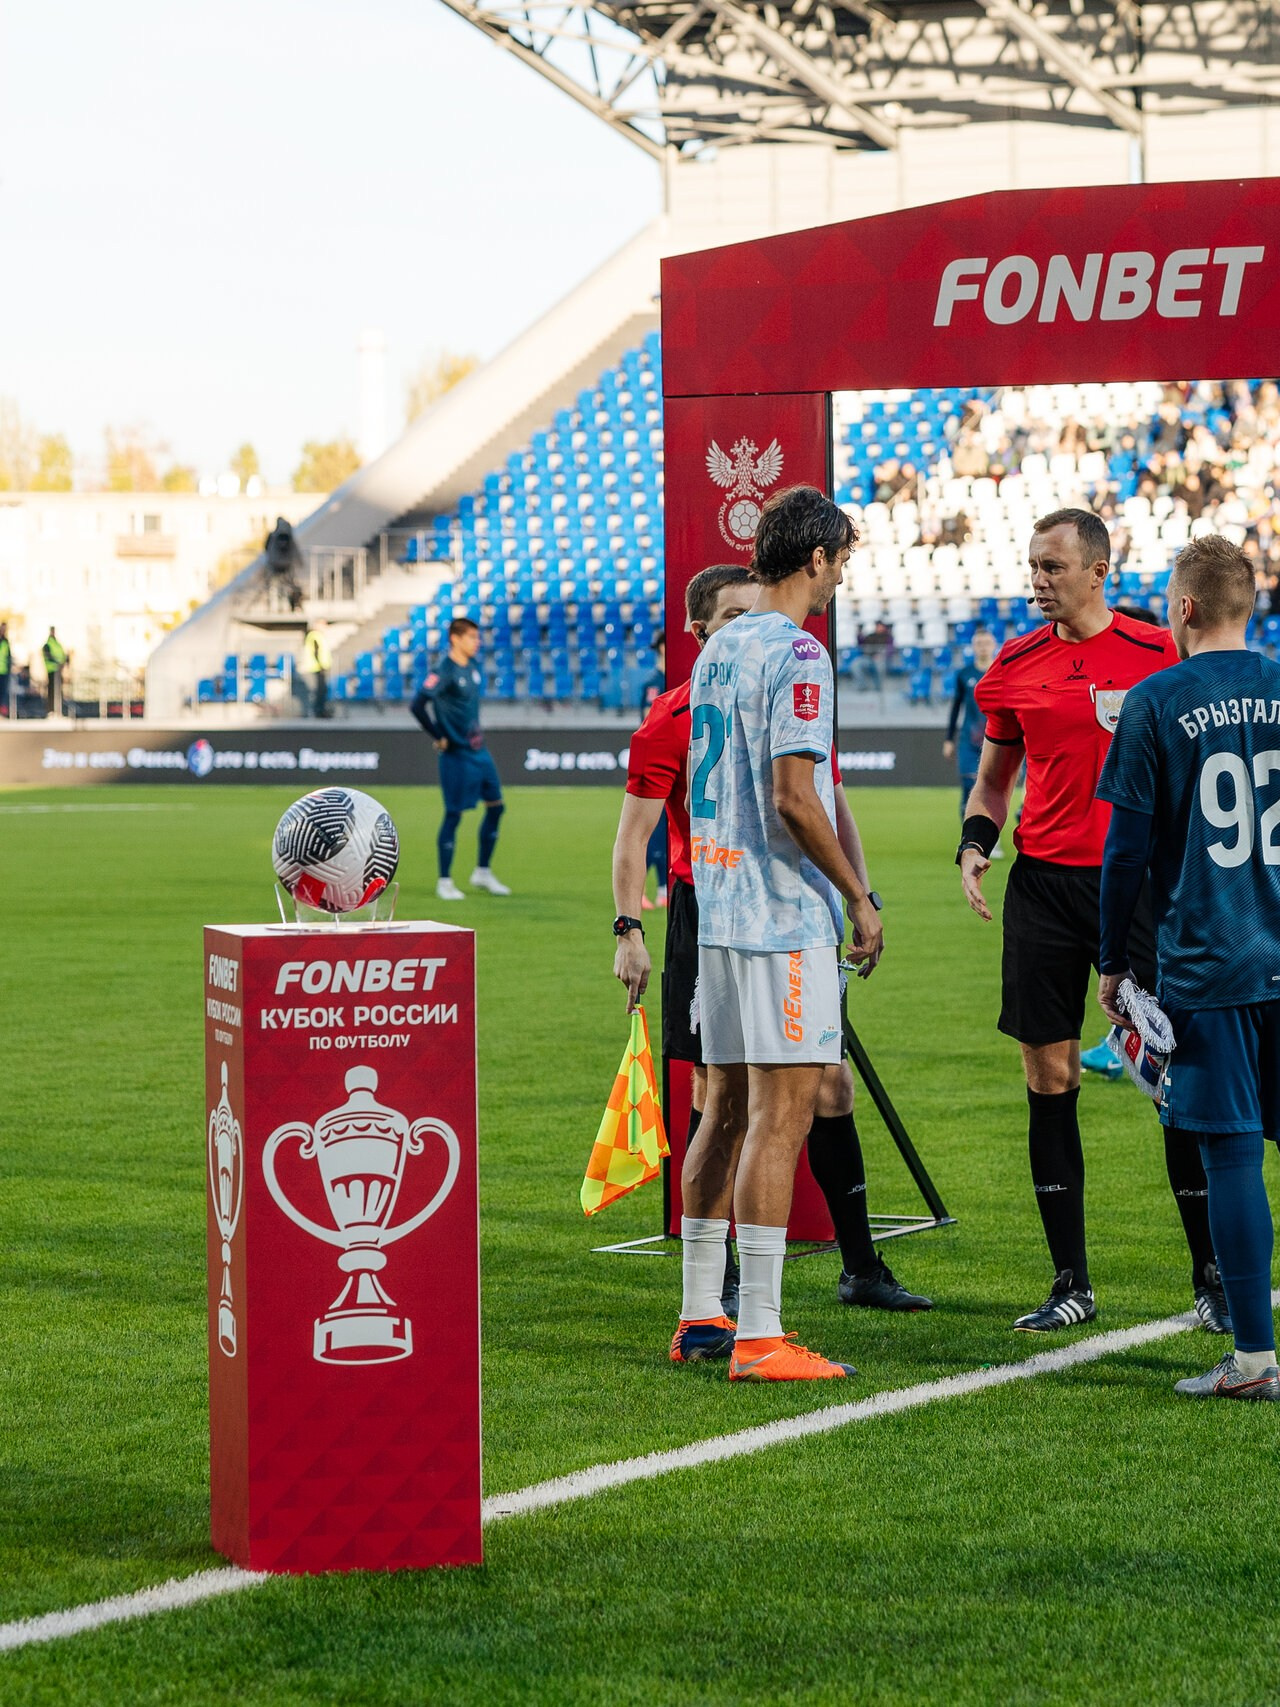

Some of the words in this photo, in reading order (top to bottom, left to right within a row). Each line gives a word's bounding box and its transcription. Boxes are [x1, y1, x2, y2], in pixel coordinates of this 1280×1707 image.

[933, 246, 1265, 326] FONBET
[794, 641, 819, 654] wb
[208, 954, 239, 992] FONBET
[275, 958, 447, 995] FONBET
[260, 1007, 345, 1029] КУБОК
[354, 1003, 458, 1026] РОССИИ
[309, 1036, 332, 1050] ПО
[334, 1034, 411, 1049] ФУТБОЛУ
